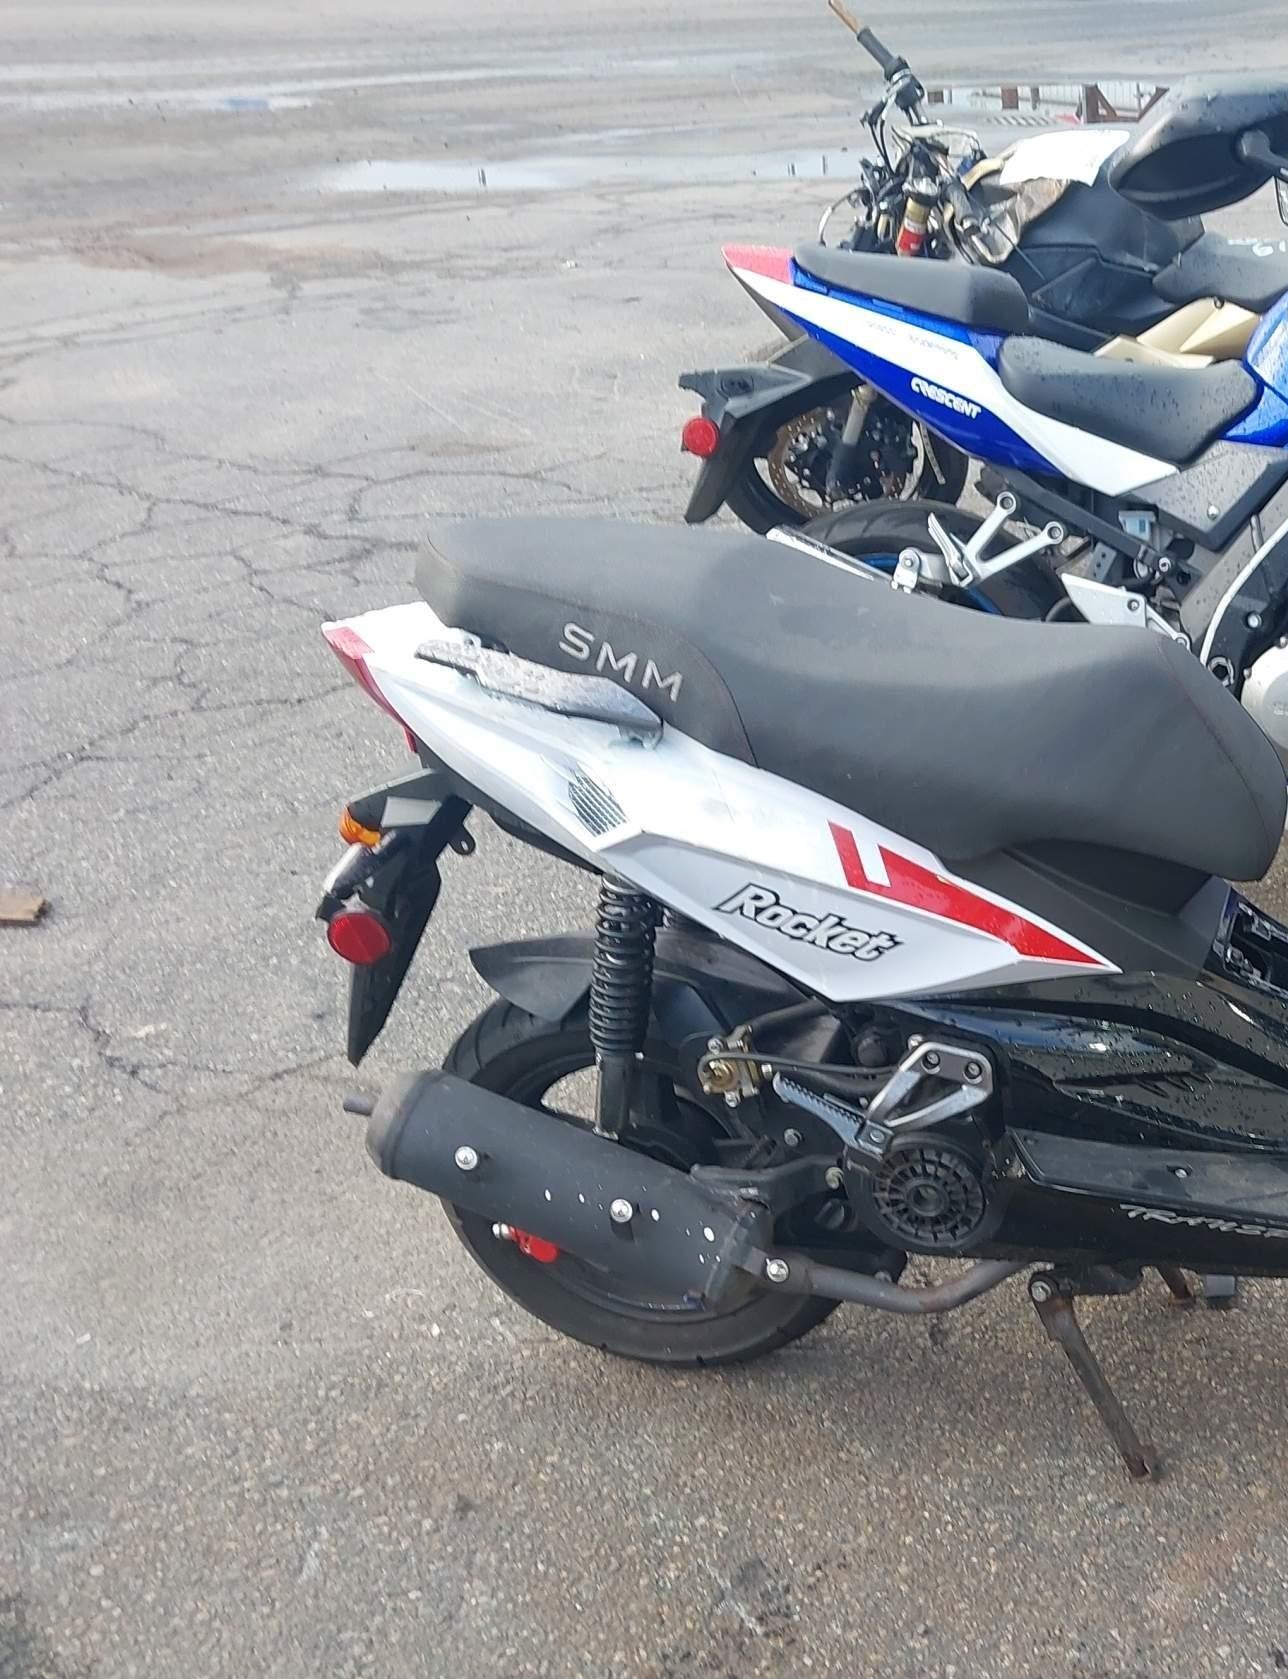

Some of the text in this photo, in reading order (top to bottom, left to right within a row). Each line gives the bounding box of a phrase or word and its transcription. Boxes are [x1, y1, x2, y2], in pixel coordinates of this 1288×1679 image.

[911, 377, 982, 419] CRESCENT
[559, 622, 683, 702] SMM
[712, 883, 904, 961] Rocket
